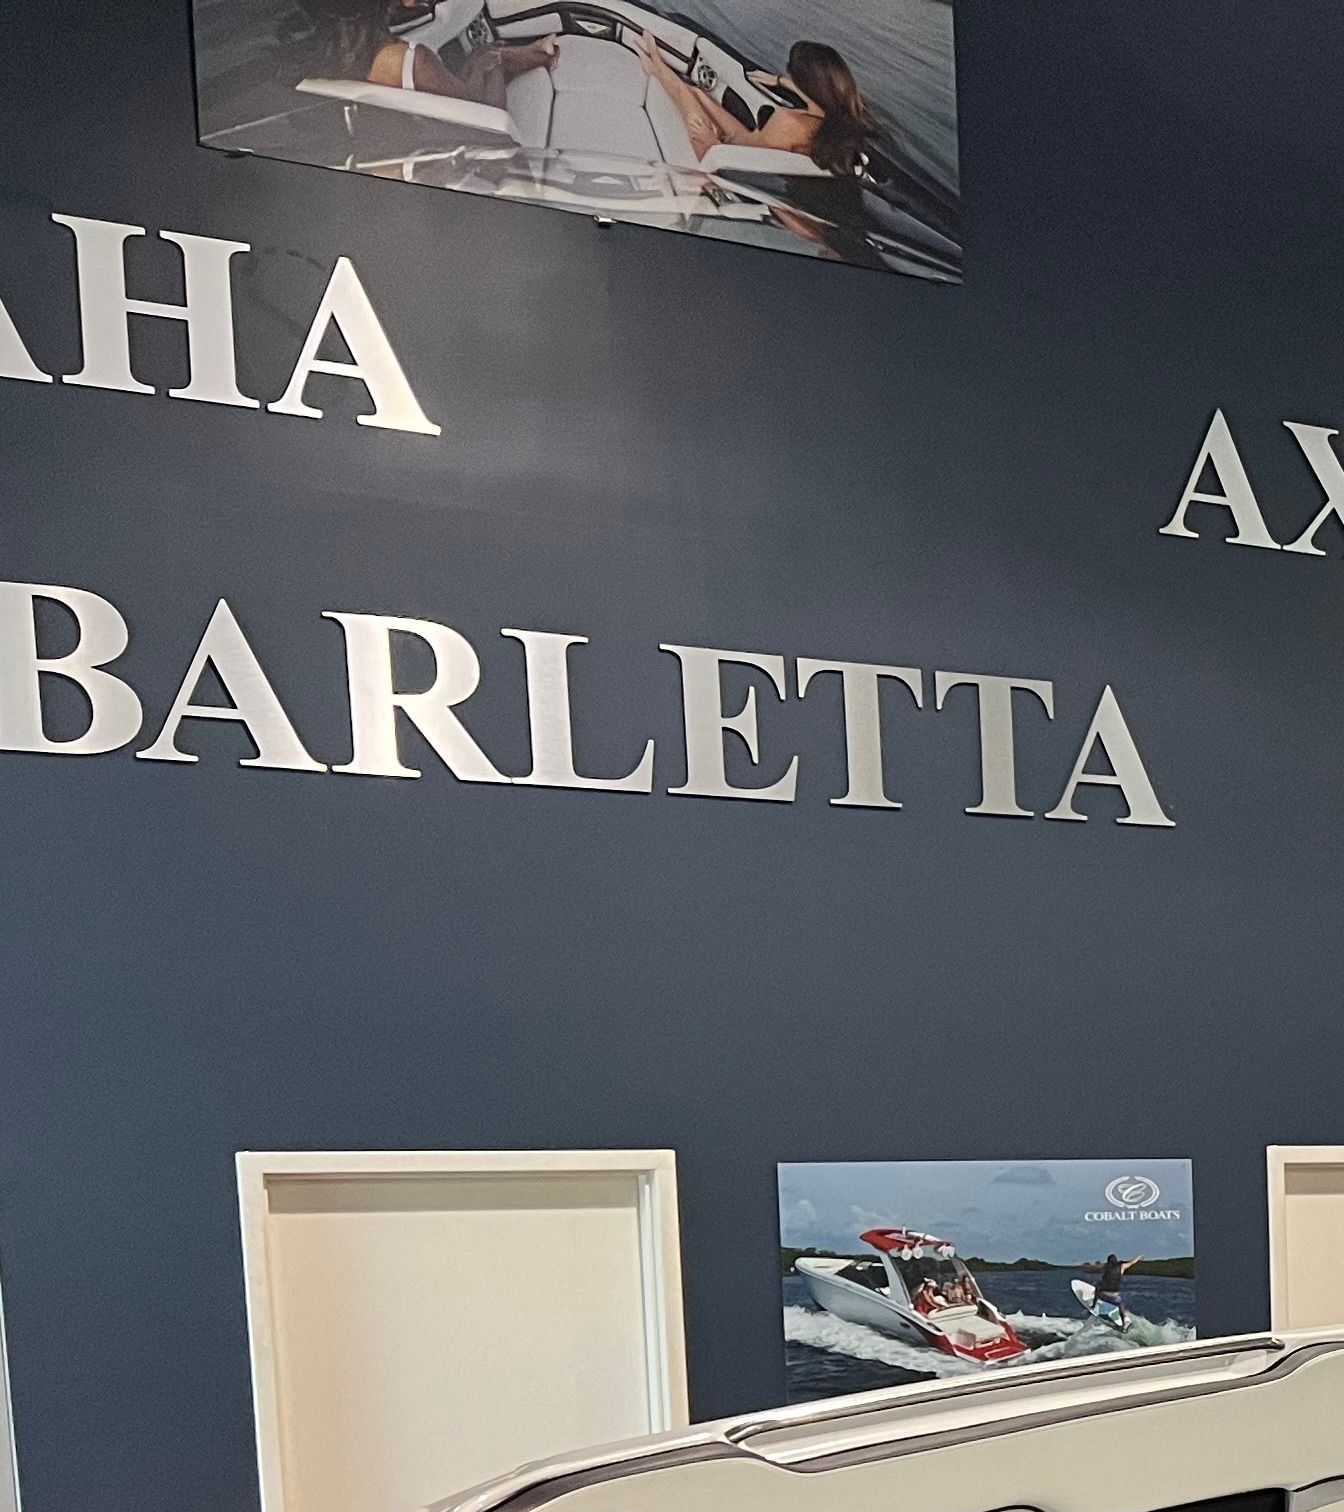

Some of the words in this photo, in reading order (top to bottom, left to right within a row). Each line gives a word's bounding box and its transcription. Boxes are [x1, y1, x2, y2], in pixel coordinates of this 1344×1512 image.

[0, 580, 1176, 828] BARLETTA
[1084, 1211, 1137, 1222] COBALT
[1139, 1210, 1181, 1220] BOATS
